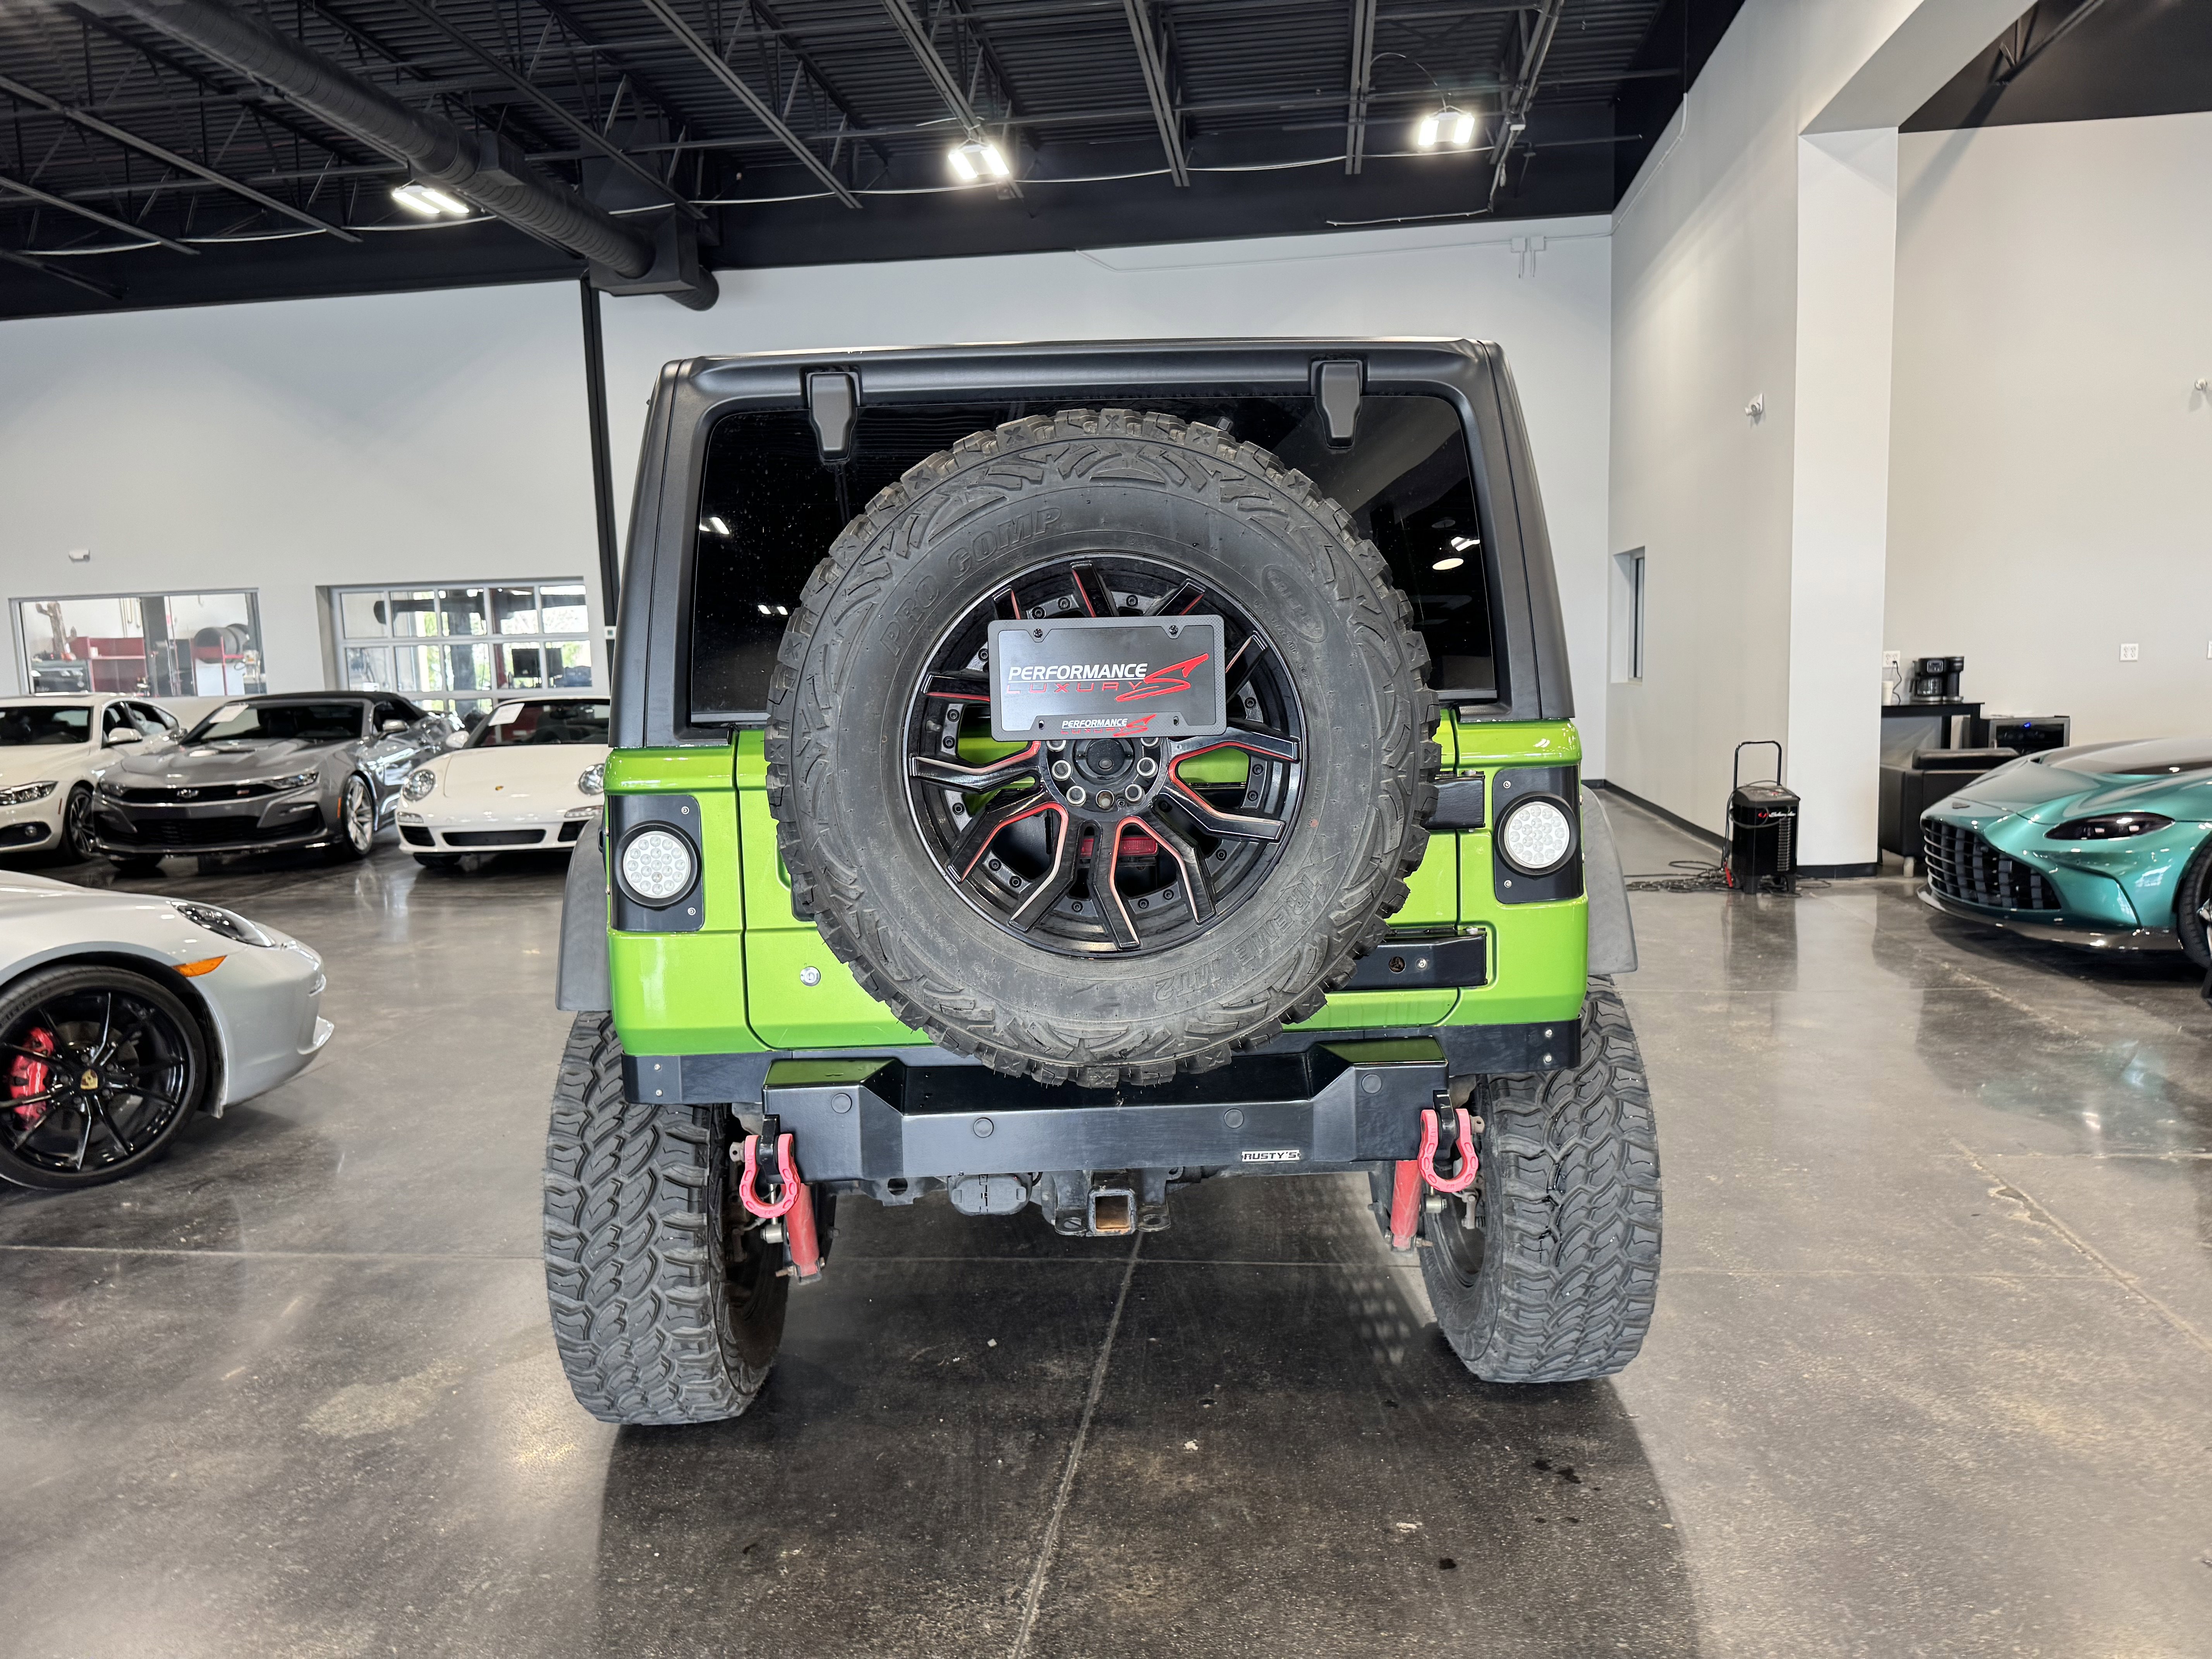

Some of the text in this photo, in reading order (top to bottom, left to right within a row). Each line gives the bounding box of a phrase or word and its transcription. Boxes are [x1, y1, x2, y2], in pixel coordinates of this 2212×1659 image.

[879, 575, 939, 656] PRO
[948, 507, 1062, 580] COMP
[1008, 663, 1148, 681] PERFORMANCE
[1006, 680, 1143, 694] LUXURY
[1061, 718, 1128, 728] PERFORMANCE
[1155, 954, 1221, 1001] MT2
[1243, 1151, 1297, 1160] RUSTY'S
